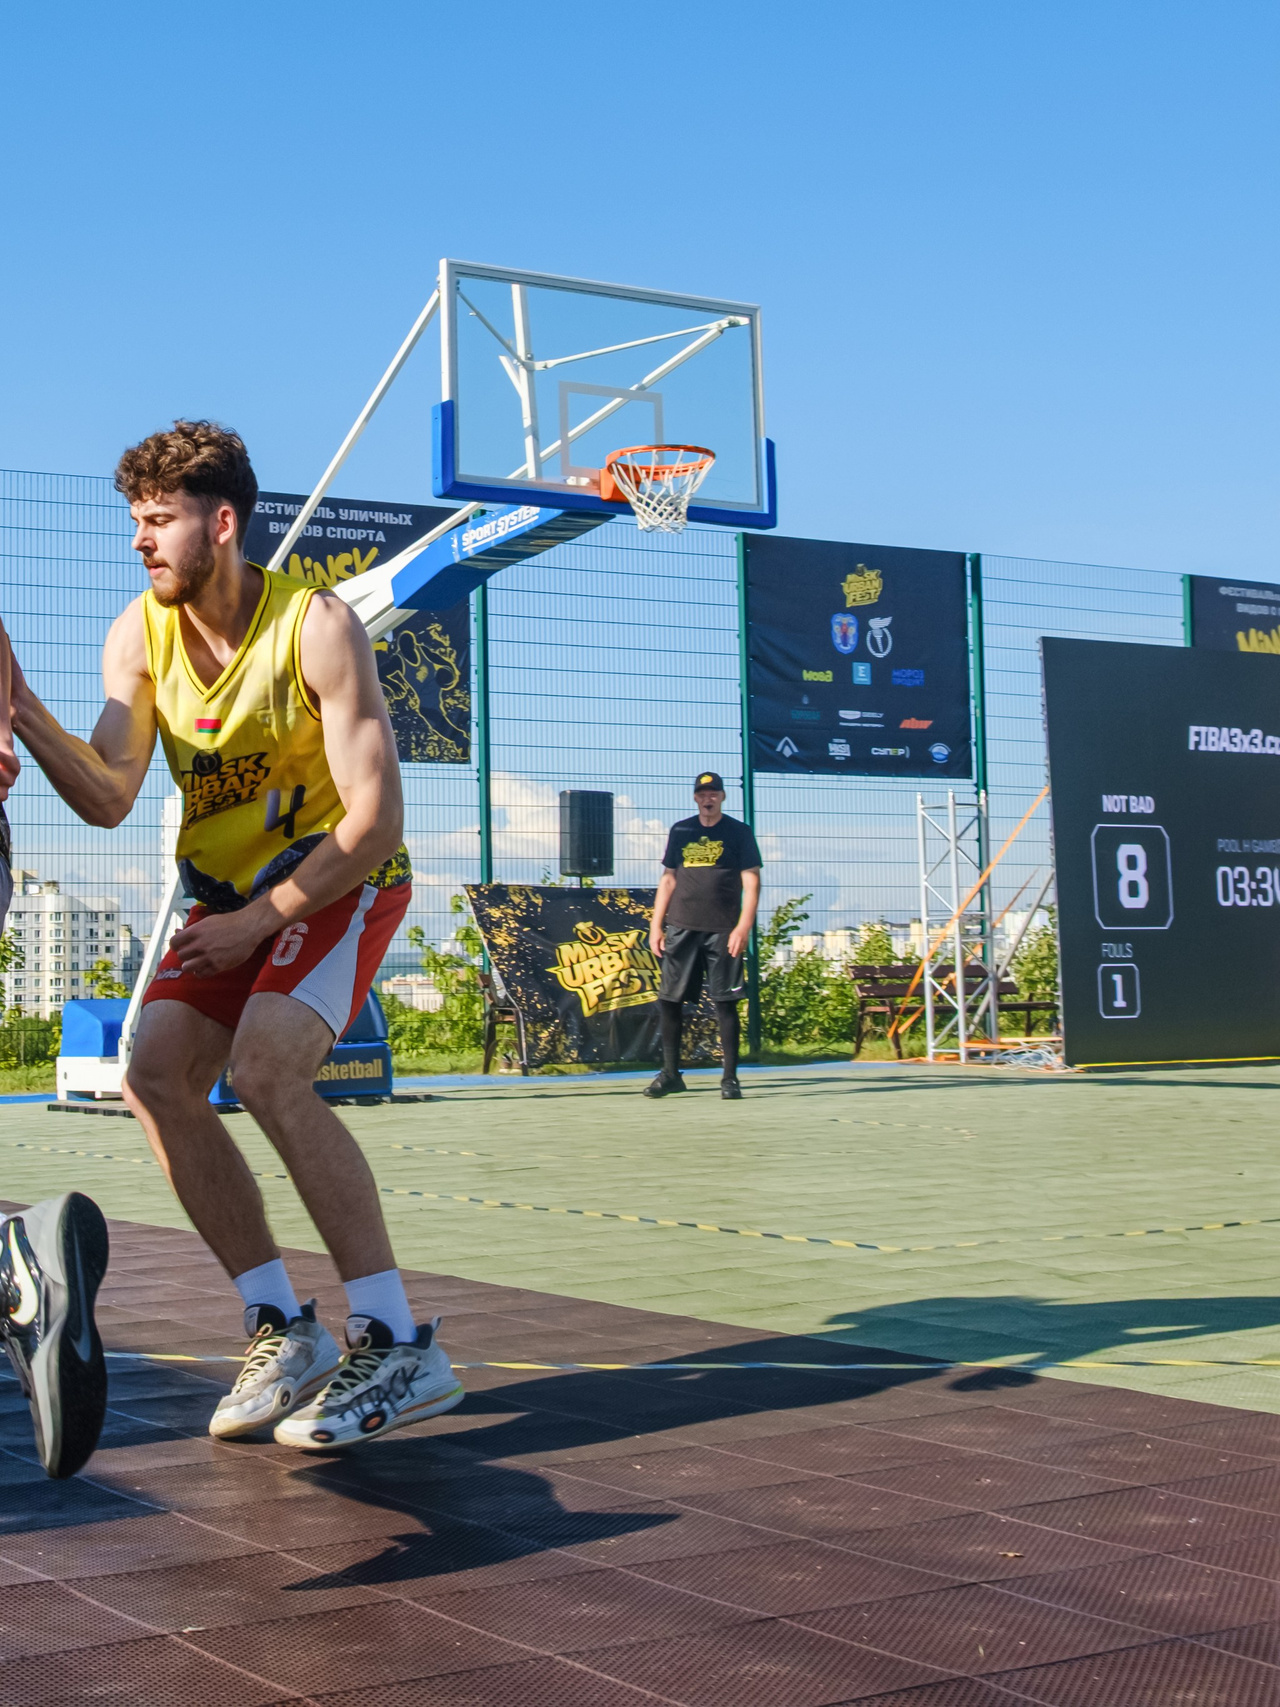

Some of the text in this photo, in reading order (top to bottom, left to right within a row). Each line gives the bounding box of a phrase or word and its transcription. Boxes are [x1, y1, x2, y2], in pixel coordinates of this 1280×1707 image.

[269, 521, 387, 543] ВИОВ СПОРТА
[338, 508, 413, 526] УЛИЧНЫХ
[185, 768, 266, 811] RBAN
[1102, 795, 1155, 813] NOT BAD
[264, 784, 307, 838] 4
[1217, 838, 1242, 852] POOL
[1117, 844, 1149, 908] 8
[272, 922, 308, 966] 6
[558, 932, 640, 966] MINSK
[1102, 943, 1133, 958] FOULS
[560, 949, 654, 987] URBAN
[581, 968, 654, 1010] FEST
[1112, 974, 1127, 1007] 1
